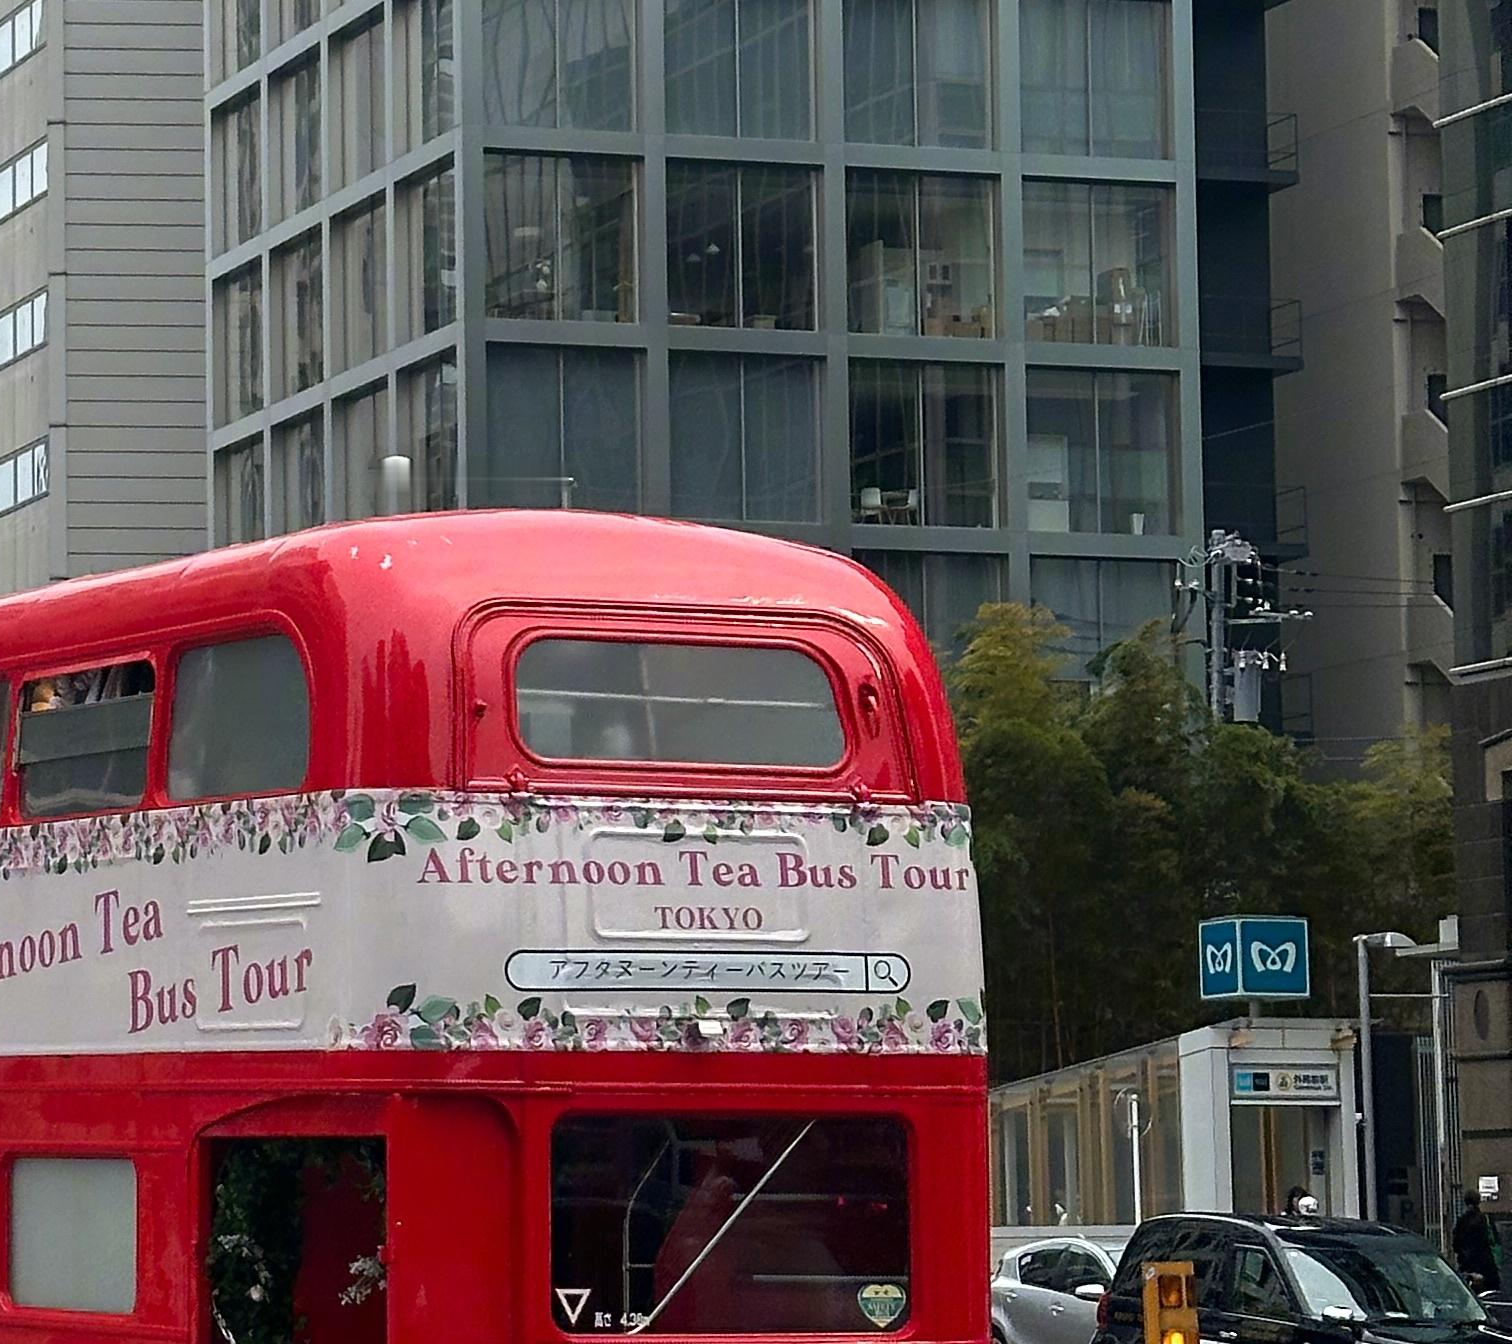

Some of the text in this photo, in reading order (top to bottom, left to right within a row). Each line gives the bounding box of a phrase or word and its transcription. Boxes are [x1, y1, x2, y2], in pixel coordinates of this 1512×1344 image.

[417, 847, 969, 892] Afternoon Tea Bus Tour
[95, 889, 165, 955] Tea
[654, 906, 765, 932] TOKYO
[129, 944, 312, 1034] Bus Tour
[549, 960, 850, 981] アフタヌーンティーバスツアー
